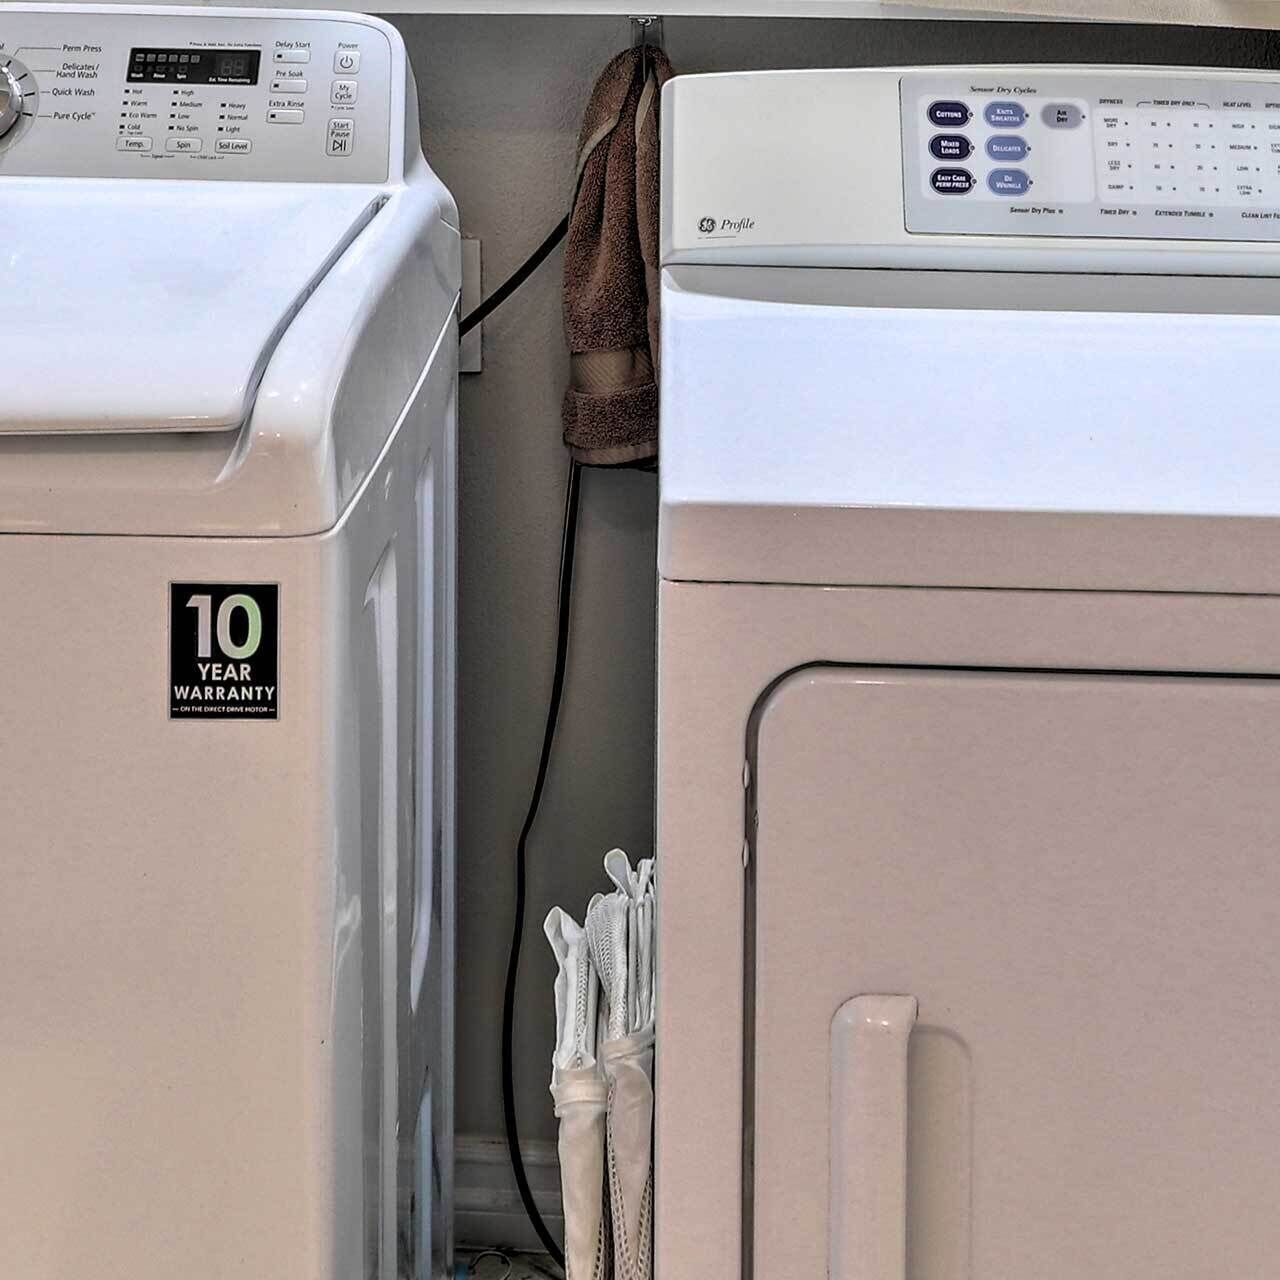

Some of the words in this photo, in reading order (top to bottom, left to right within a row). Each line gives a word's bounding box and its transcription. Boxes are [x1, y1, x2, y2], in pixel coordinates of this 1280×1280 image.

[275, 41, 293, 49] Delay
[56, 70, 74, 78] Hand
[75, 70, 98, 78] Wash
[52, 88, 73, 96] Quick
[74, 88, 95, 96] Wash
[997, 86, 1011, 94] Dry
[1013, 87, 1037, 95] Cycles
[176, 141, 191, 149] Spin
[219, 142, 231, 150] Soil
[231, 142, 248, 150] Level
[720, 217, 755, 233] Profile
[186, 593, 262, 659] 10
[198, 663, 251, 681] YEAR
[174, 686, 275, 701] WARRANTY
